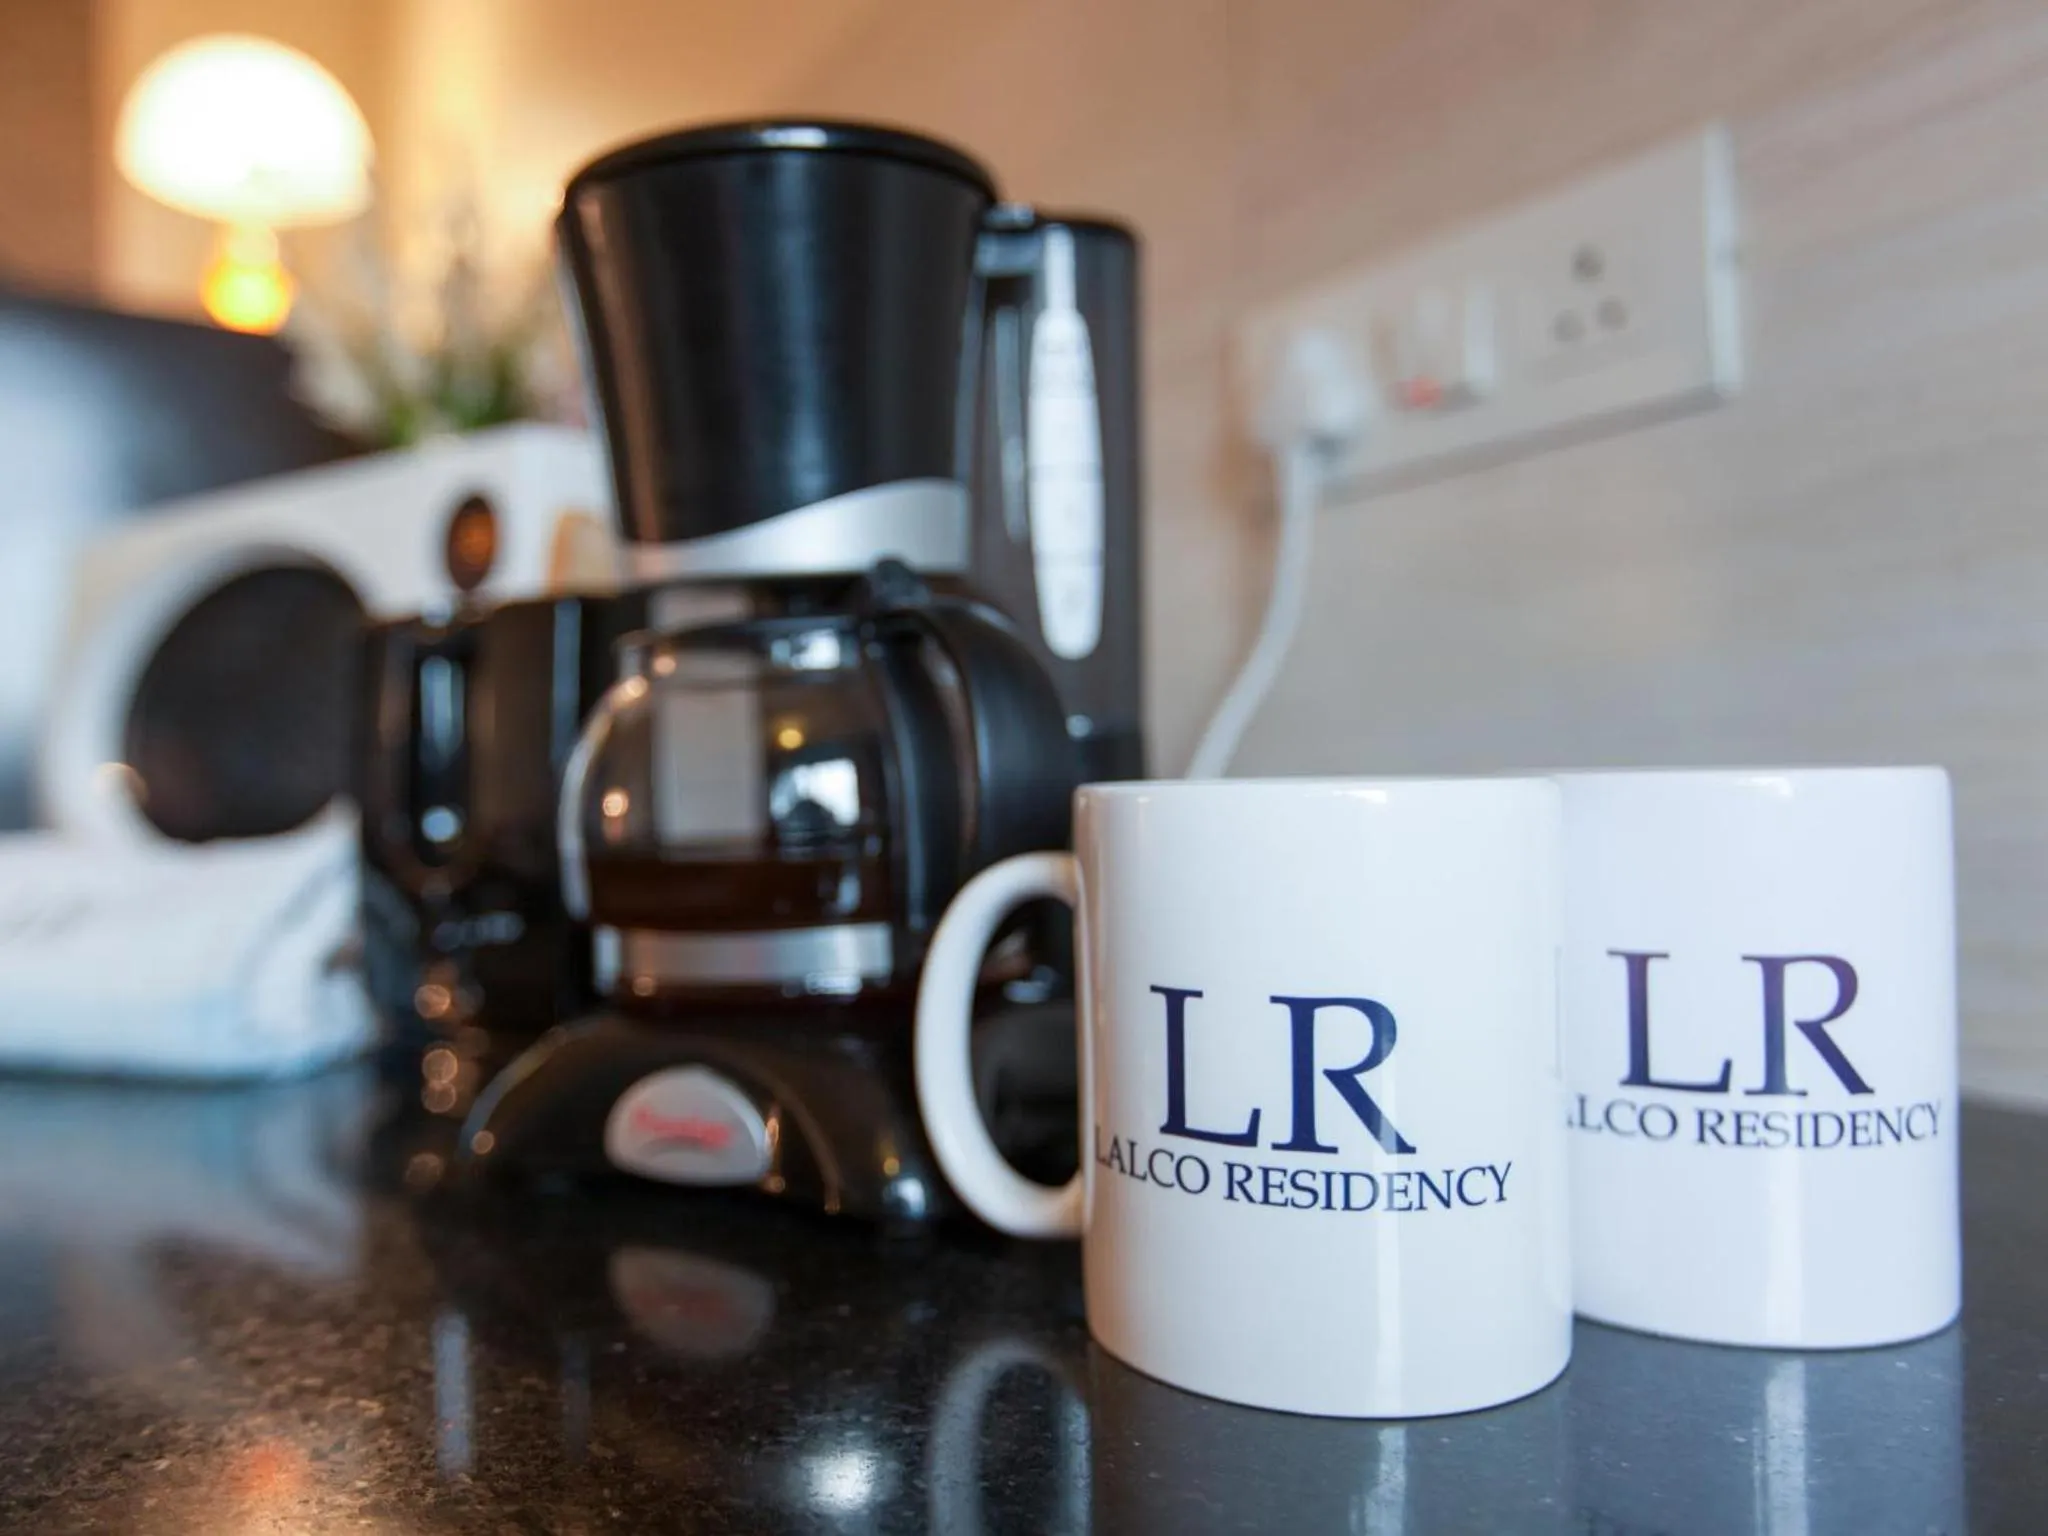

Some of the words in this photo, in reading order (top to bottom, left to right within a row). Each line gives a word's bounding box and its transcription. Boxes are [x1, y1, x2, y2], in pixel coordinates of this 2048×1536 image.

[1149, 984, 1417, 1155] LR
[1605, 948, 1876, 1097] LR
[1094, 1123, 1211, 1195] LALCO
[1222, 1160, 1513, 1212] RESIDENCY
[1566, 1092, 1678, 1141] LCO
[1695, 1098, 1942, 1149] RESIDENCY
